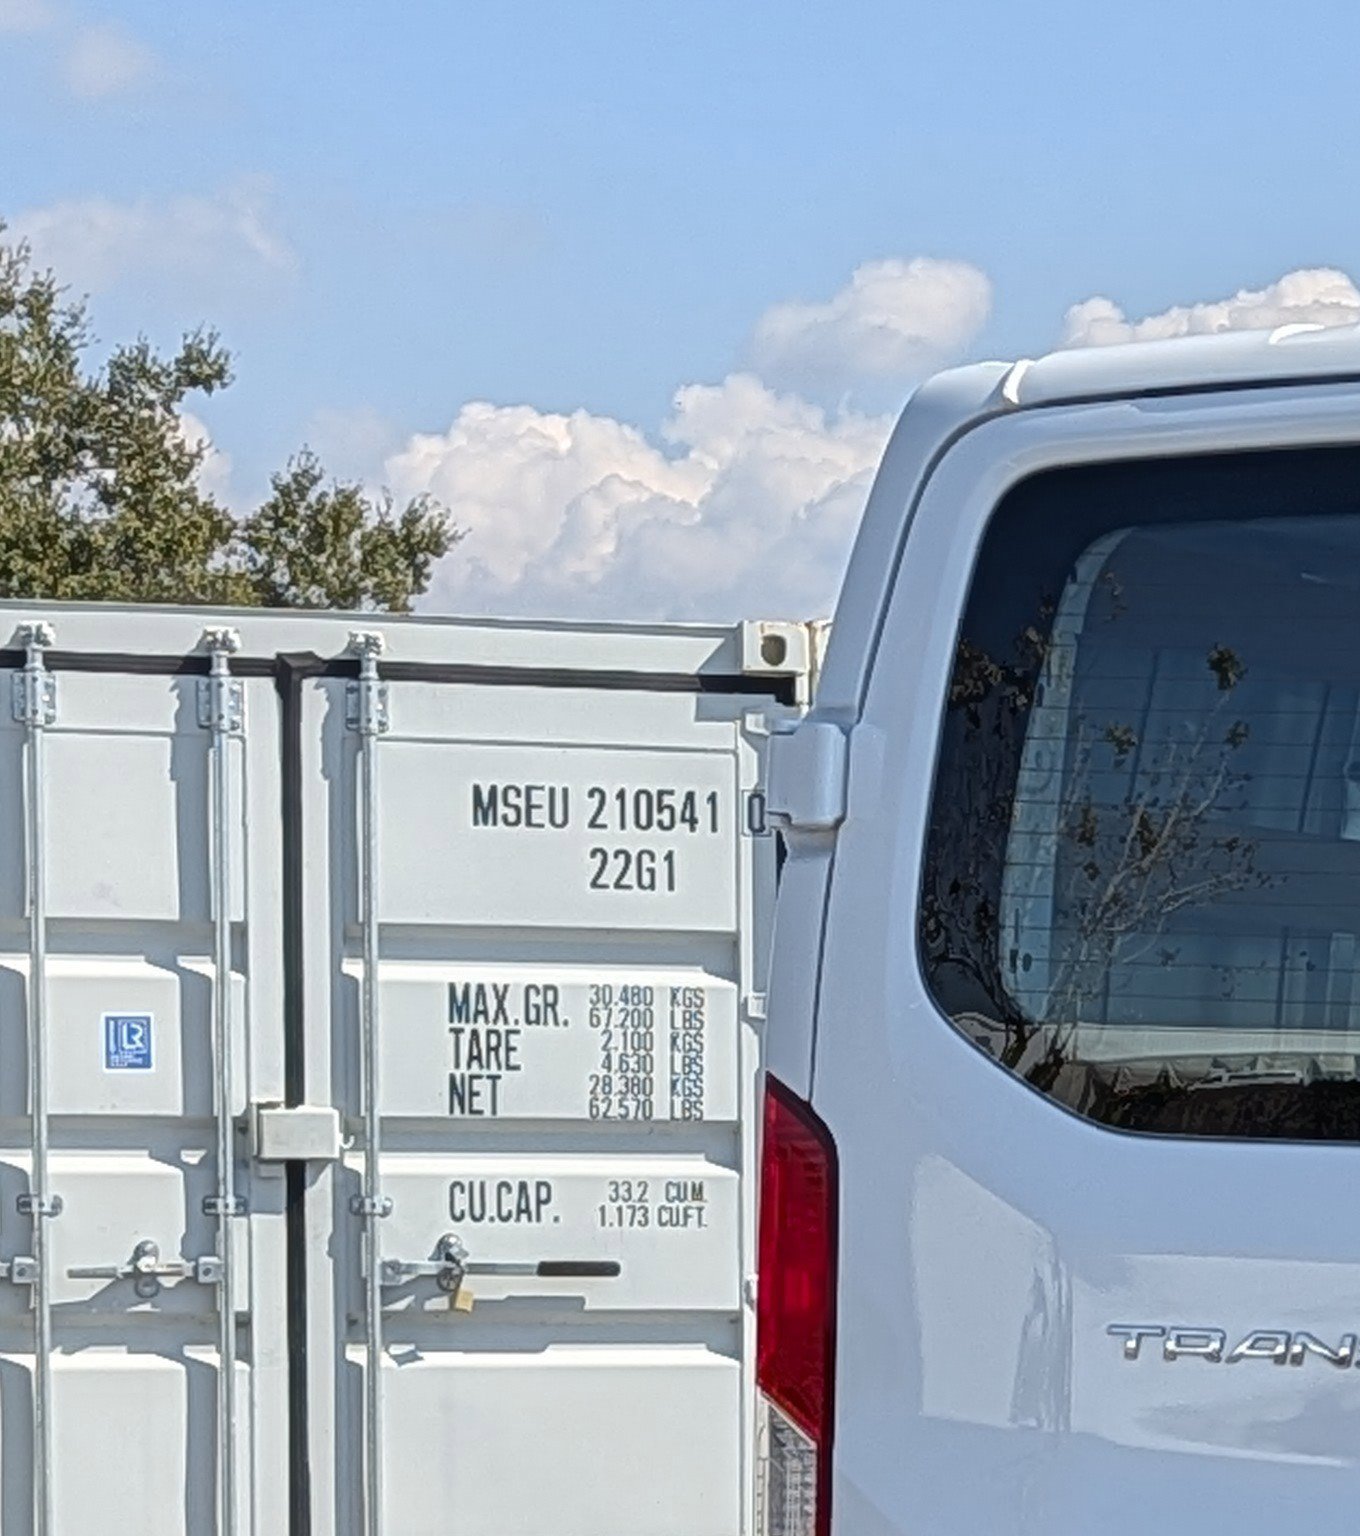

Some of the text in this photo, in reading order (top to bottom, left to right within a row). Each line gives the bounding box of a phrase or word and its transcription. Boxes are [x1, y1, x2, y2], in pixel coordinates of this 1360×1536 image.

[472, 784, 569, 829] MSEU
[587, 787, 718, 833] 210541
[589, 847, 675, 892] 22G1
[589, 984, 654, 1008] 30.480
[670, 986, 704, 1008] KGS
[588, 1007, 704, 1030] 67.200 LBS
[448, 1028, 704, 1071] TARE 2.100 KGS
[601, 1052, 704, 1075] 4.630 LBS
[448, 1073, 704, 1116] NET 28.380 KGS
[588, 1097, 704, 1121] 62.570 LBS
[449, 1180, 561, 1223] CU.CAP.
[608, 1181, 649, 1203] 33.2
[599, 1204, 649, 1227] 1.173
